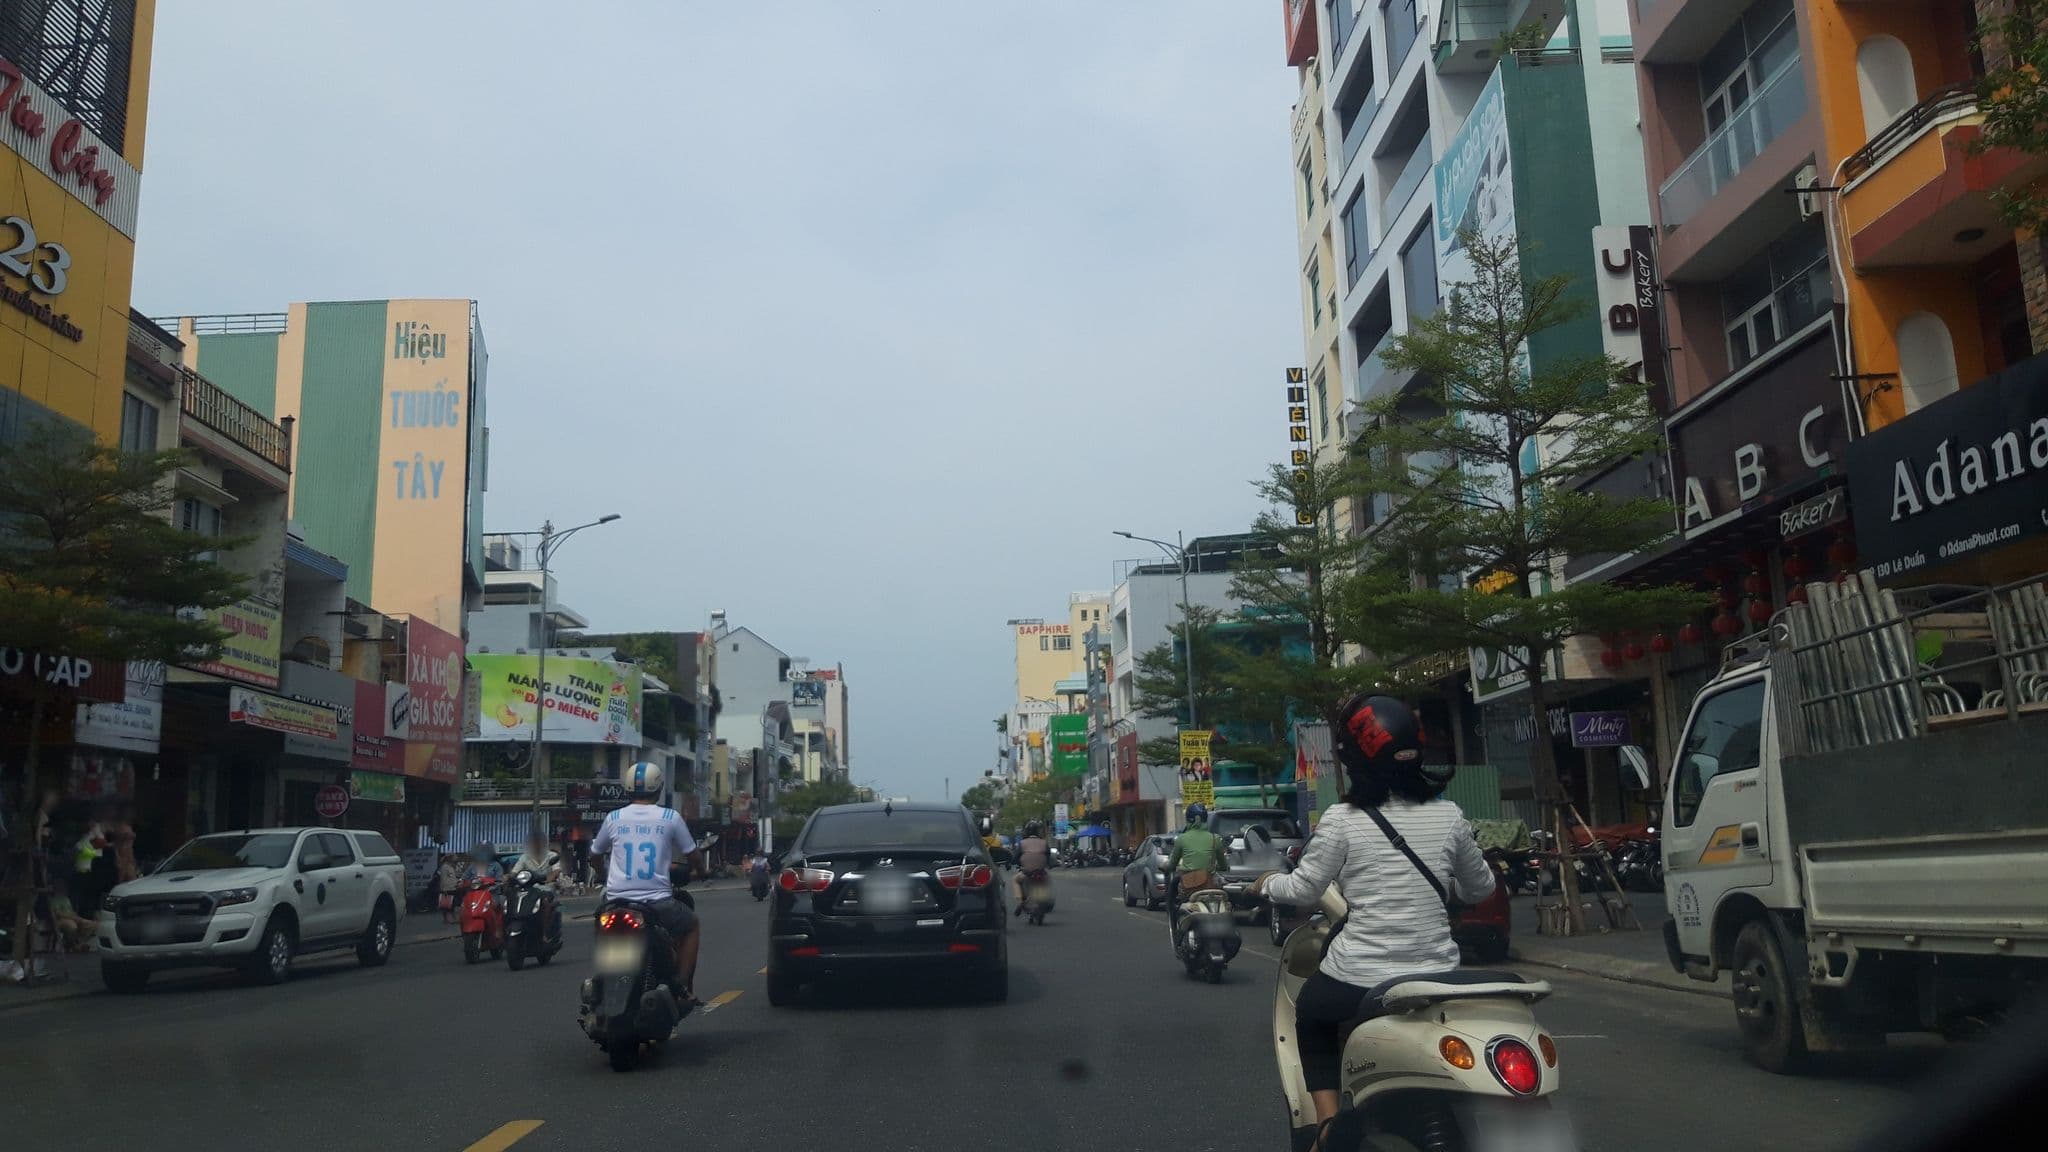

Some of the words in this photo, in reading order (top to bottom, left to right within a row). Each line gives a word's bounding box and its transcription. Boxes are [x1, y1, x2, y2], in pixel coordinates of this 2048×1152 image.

[1637, 250, 1654, 310] Bakery
[393, 321, 446, 366] Hiệu
[390, 378, 460, 430] THUỐC
[393, 452, 445, 500] TÂY
[1889, 411, 2048, 523] Adana
[1780, 490, 1839, 537] Bakery
[1019, 624, 1070, 635] SAPPHIRE
[411, 644, 428, 683] XẢ
[410, 690, 431, 726] GIÁ
[433, 690, 455, 727] SỐC
[1577, 715, 1625, 737] Minty
[622, 841, 657, 881] 13
